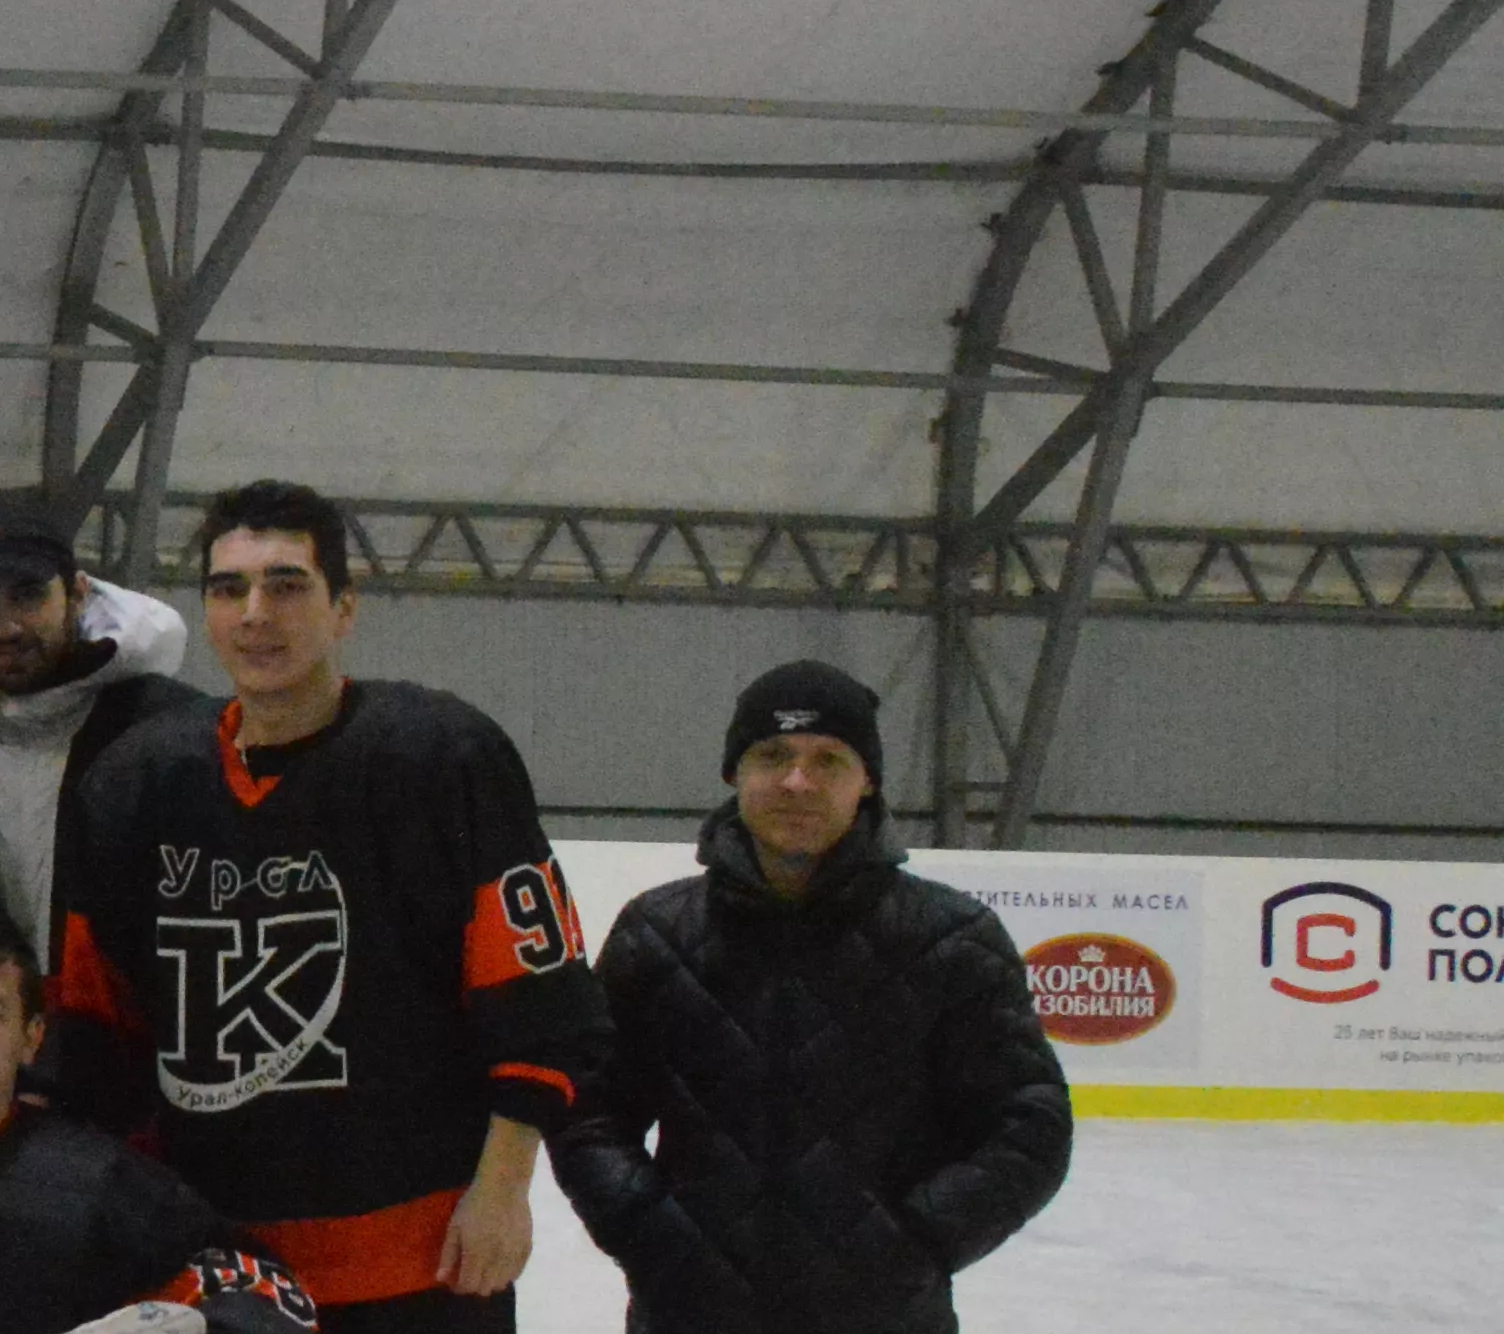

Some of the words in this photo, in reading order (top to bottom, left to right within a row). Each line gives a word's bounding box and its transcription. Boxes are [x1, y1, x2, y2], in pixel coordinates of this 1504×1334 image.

[158, 844, 336, 911] Урал
[962, 890, 1098, 908] ТИТЕЛЬНЫХ
[1112, 893, 1189, 911] МАСЕЛ
[1025, 964, 1156, 994] КОРОНА
